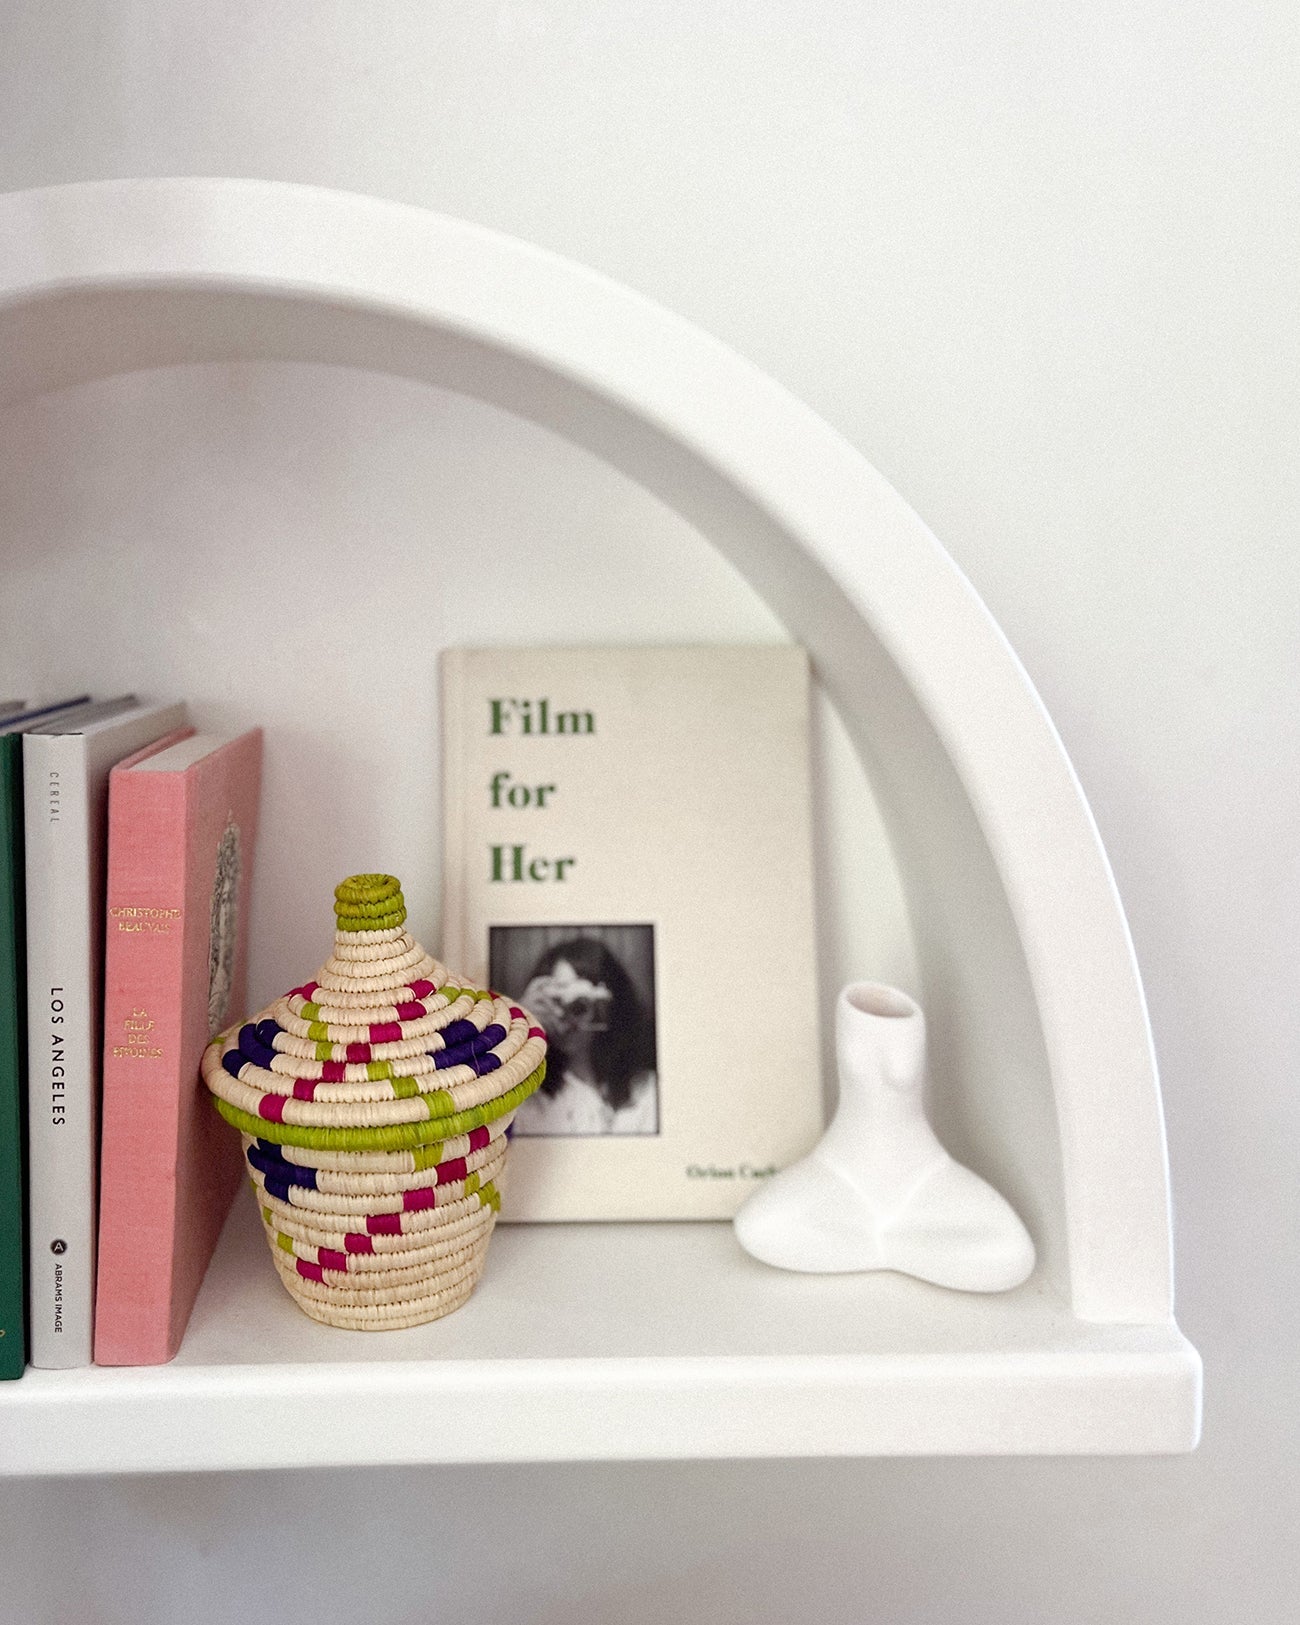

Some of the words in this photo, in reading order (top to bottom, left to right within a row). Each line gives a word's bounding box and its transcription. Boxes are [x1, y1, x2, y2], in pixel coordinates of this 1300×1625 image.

[489, 697, 597, 736] Film
[50, 771, 60, 823] CEREAL
[490, 771, 556, 808] for
[490, 844, 576, 884] Her
[50, 987, 64, 1025] LOS
[51, 1035, 66, 1126] ANGELES
[54, 1263, 63, 1302] ABRAMS
[54, 1304, 63, 1333] IMAGE
